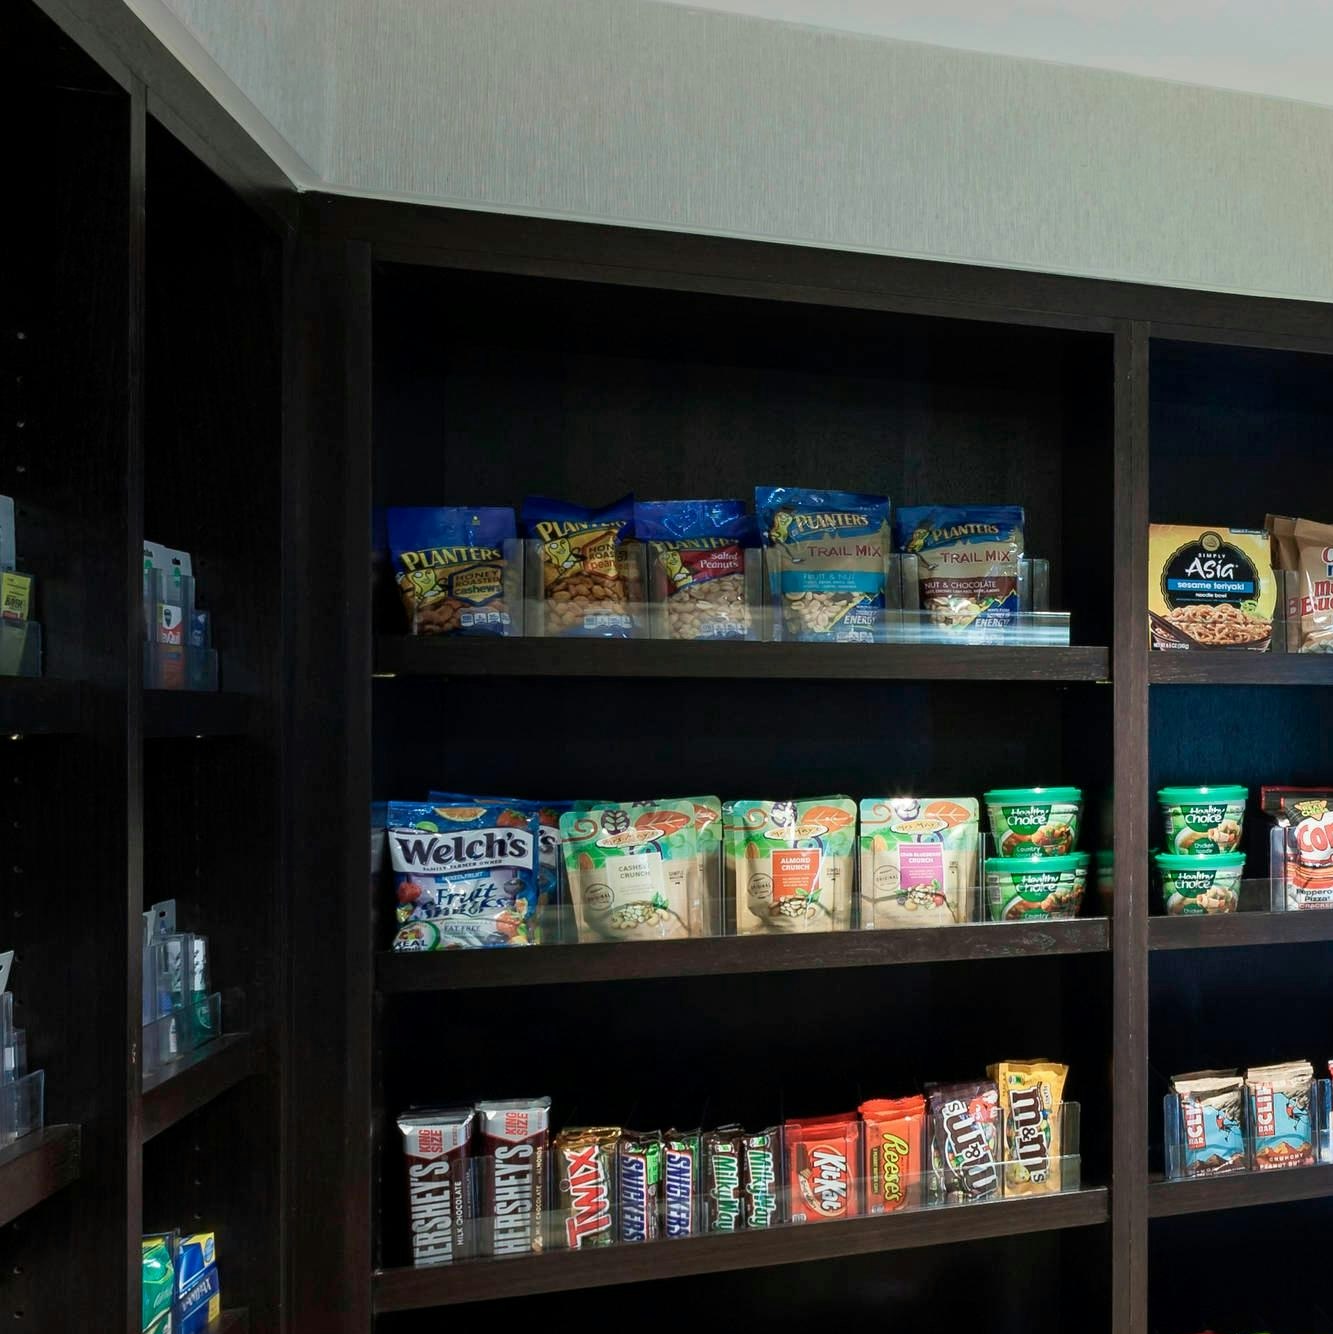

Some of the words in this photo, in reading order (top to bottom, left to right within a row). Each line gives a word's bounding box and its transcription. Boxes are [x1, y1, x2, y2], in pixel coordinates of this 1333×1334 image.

[795, 513, 868, 531] PLANTERS
[932, 524, 998, 540] PLANTERS
[401, 547, 500, 572] PLANTERS
[808, 546, 851, 558] TRAIL
[855, 545, 881, 558] MIX
[940, 552, 982, 563] TRAIL
[986, 551, 1010, 562] MIX
[700, 559, 739, 569] Peanuts
[1185, 558, 1234, 580] Asia
[1177, 582, 1211, 590] sesame
[1214, 581, 1244, 591] teriyaki
[1185, 814, 1222, 824] Choice
[395, 831, 527, 865] Welch's
[780, 857, 811, 865] ALMOND
[781, 863, 810, 871] CRUNCH
[1175, 879, 1210, 889] Choice
[506, 1112, 516, 1135] KING
[517, 1112, 528, 1136] SIZE
[1011, 1087, 1049, 1183] m&m's
[1258, 1125, 1273, 1133] BAR
[419, 1129, 430, 1153] KING
[430, 1130, 442, 1153] SIZE
[942, 1101, 997, 1200] m&m's
[813, 1151, 846, 1180] Kit
[883, 1133, 909, 1200] Reese's
[494, 1144, 534, 1254] HERSHEY'S
[566, 1145, 612, 1249] TWIX
[622, 1156, 645, 1242] SNICKERS
[666, 1154, 691, 1238] SNICKERS
[815, 1178, 846, 1211] Kat
